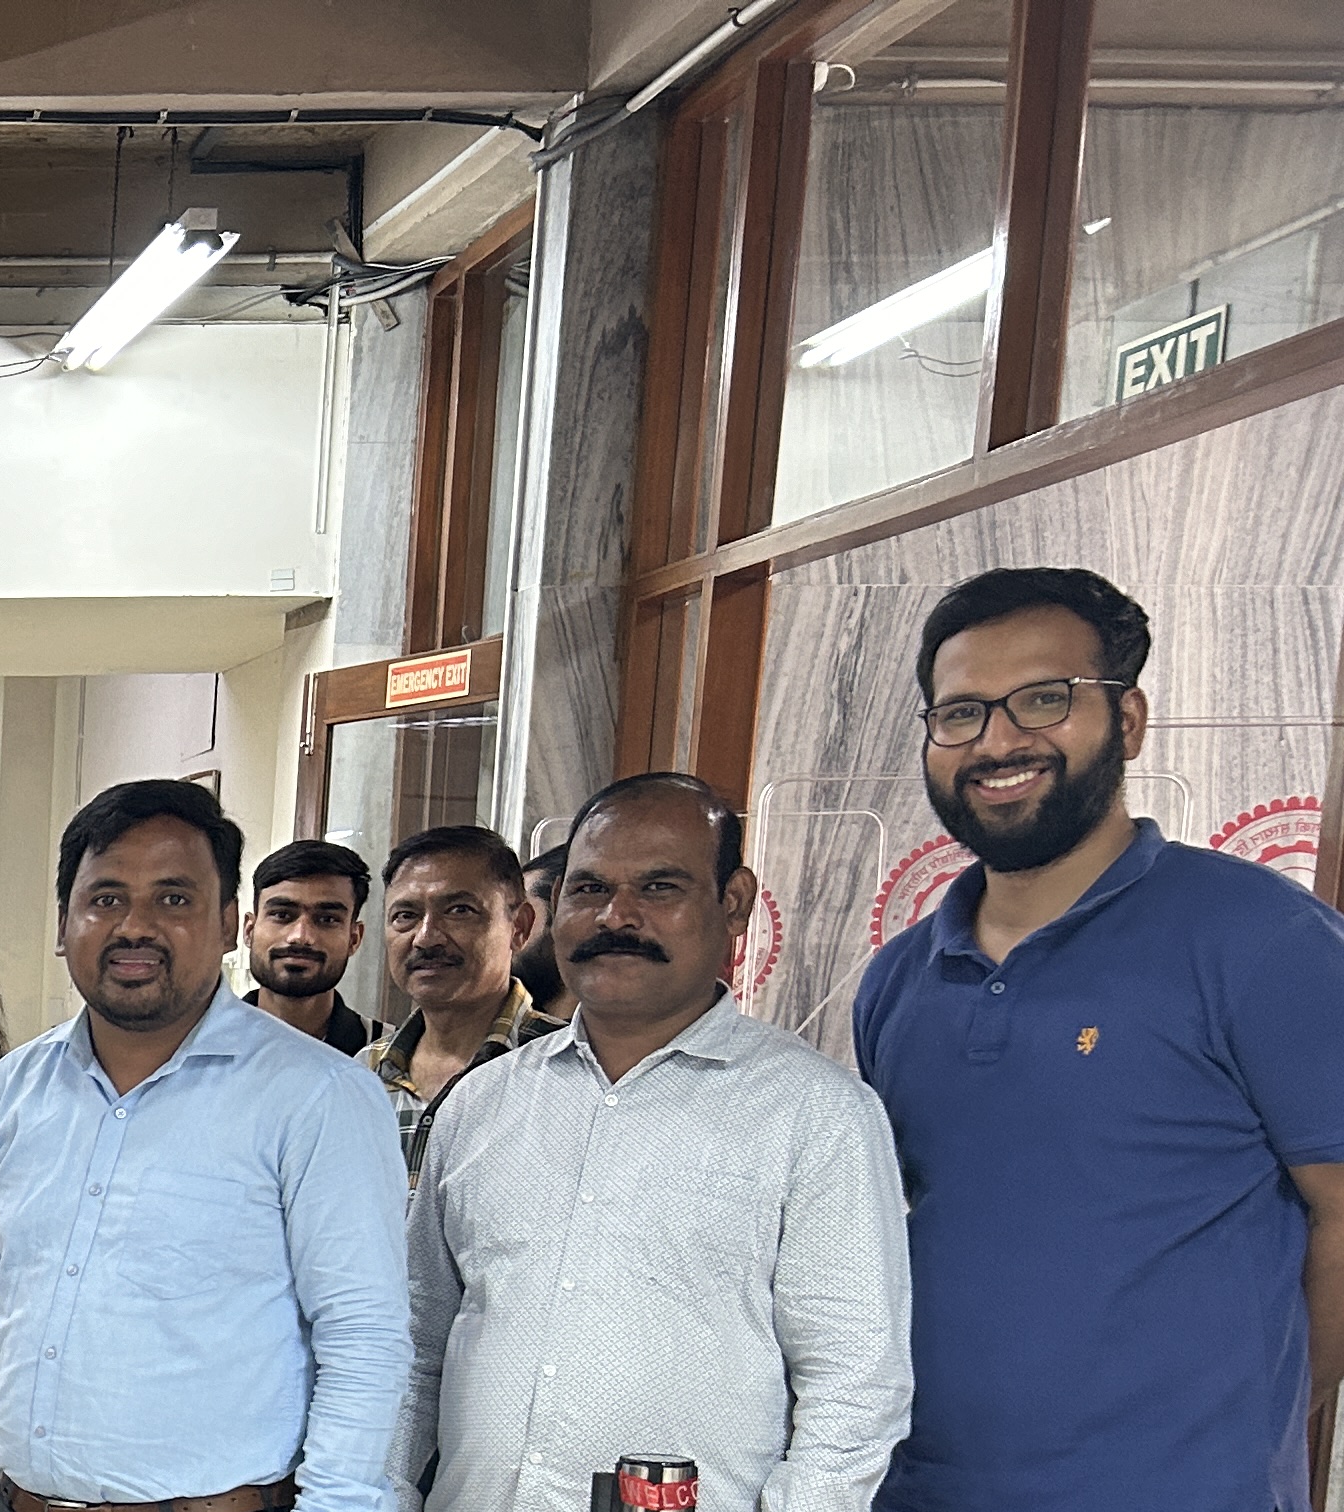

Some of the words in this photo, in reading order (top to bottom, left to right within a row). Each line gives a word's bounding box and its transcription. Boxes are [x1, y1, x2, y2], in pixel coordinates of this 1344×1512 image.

[1122, 321, 1216, 400] EXIT
[391, 666, 444, 696] EMERGENCY
[445, 661, 467, 686] EXIT
